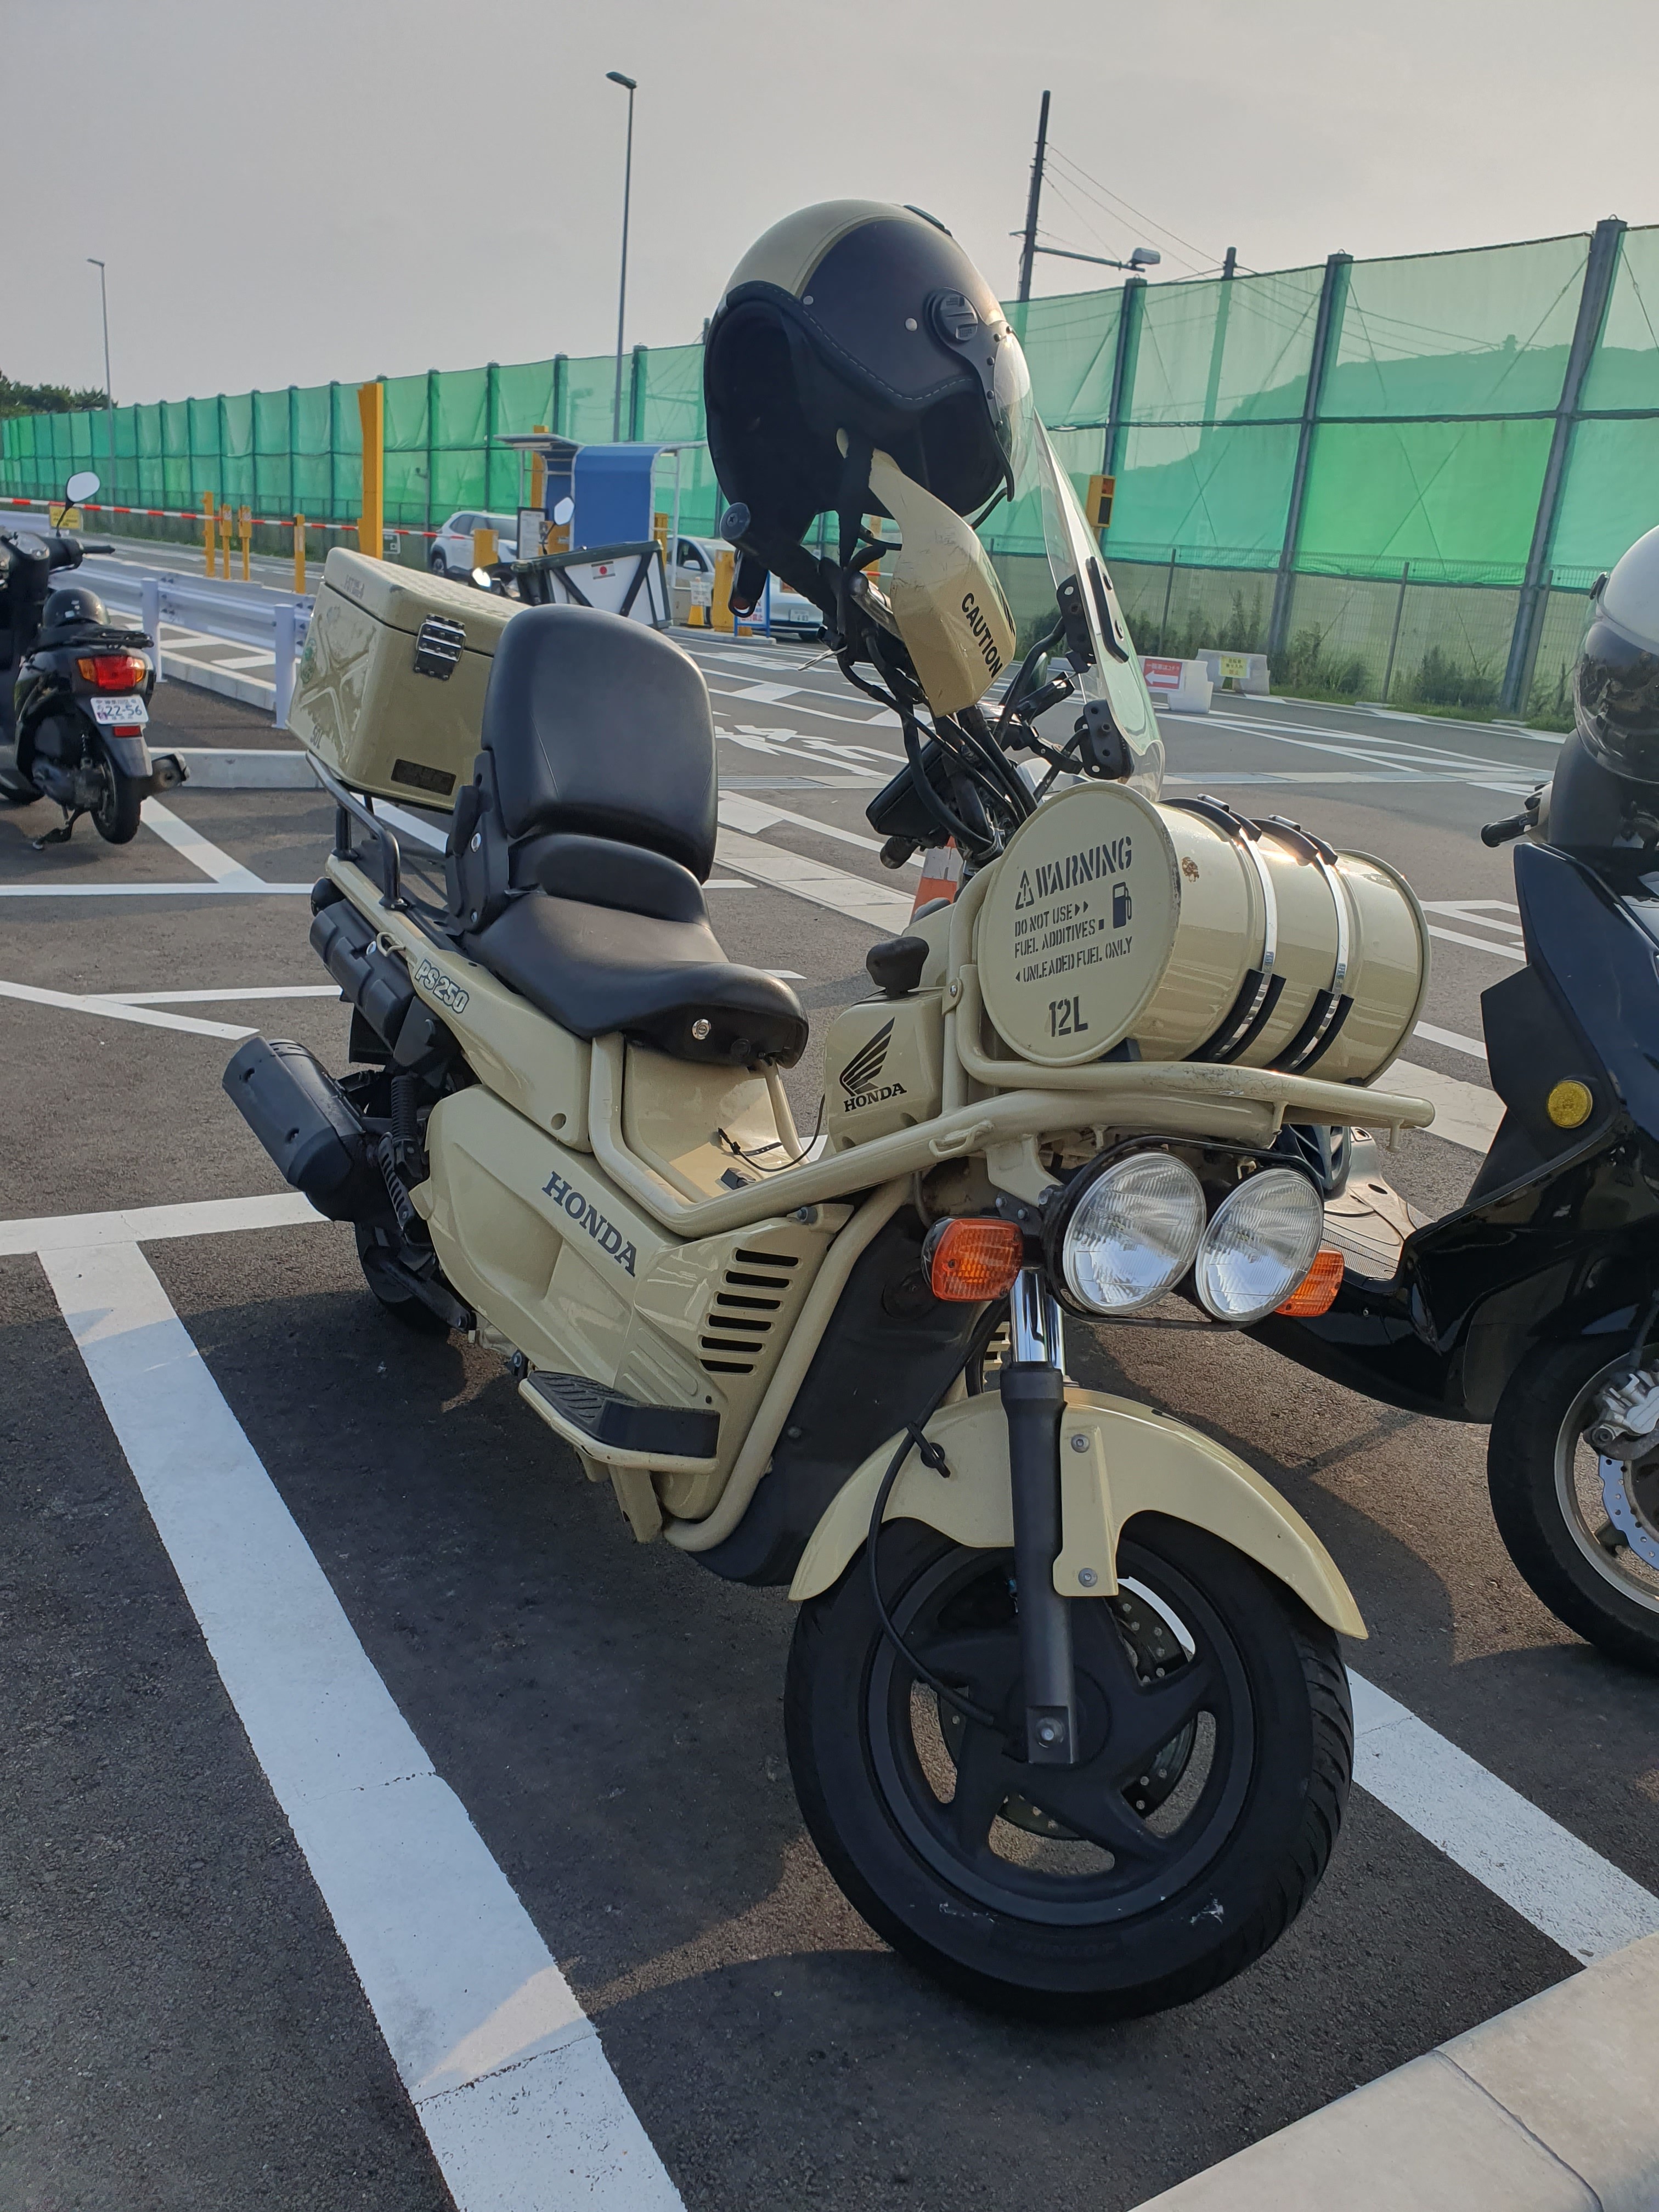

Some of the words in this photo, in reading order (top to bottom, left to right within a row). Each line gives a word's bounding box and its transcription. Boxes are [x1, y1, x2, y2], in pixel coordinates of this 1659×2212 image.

[961, 592, 1003, 679] CAUTION
[105, 705, 143, 716] 22-56
[1035, 836, 1132, 898] WARNING
[1014, 920, 1028, 937] DO
[1030, 911, 1050, 932] NOT
[1052, 904, 1073, 923] USE
[1014, 938, 1039, 959] FUEL
[1042, 918, 1096, 950] ADDITIVES
[1023, 954, 1075, 983] UNLEADED
[1076, 946, 1102, 964] FUEL
[1105, 936, 1132, 958] ONLY
[415, 958, 470, 1014] PS250
[1049, 995, 1088, 1037] 12L
[843, 1082, 907, 1113] HONDA
[541, 1171, 637, 1277] HONDA
